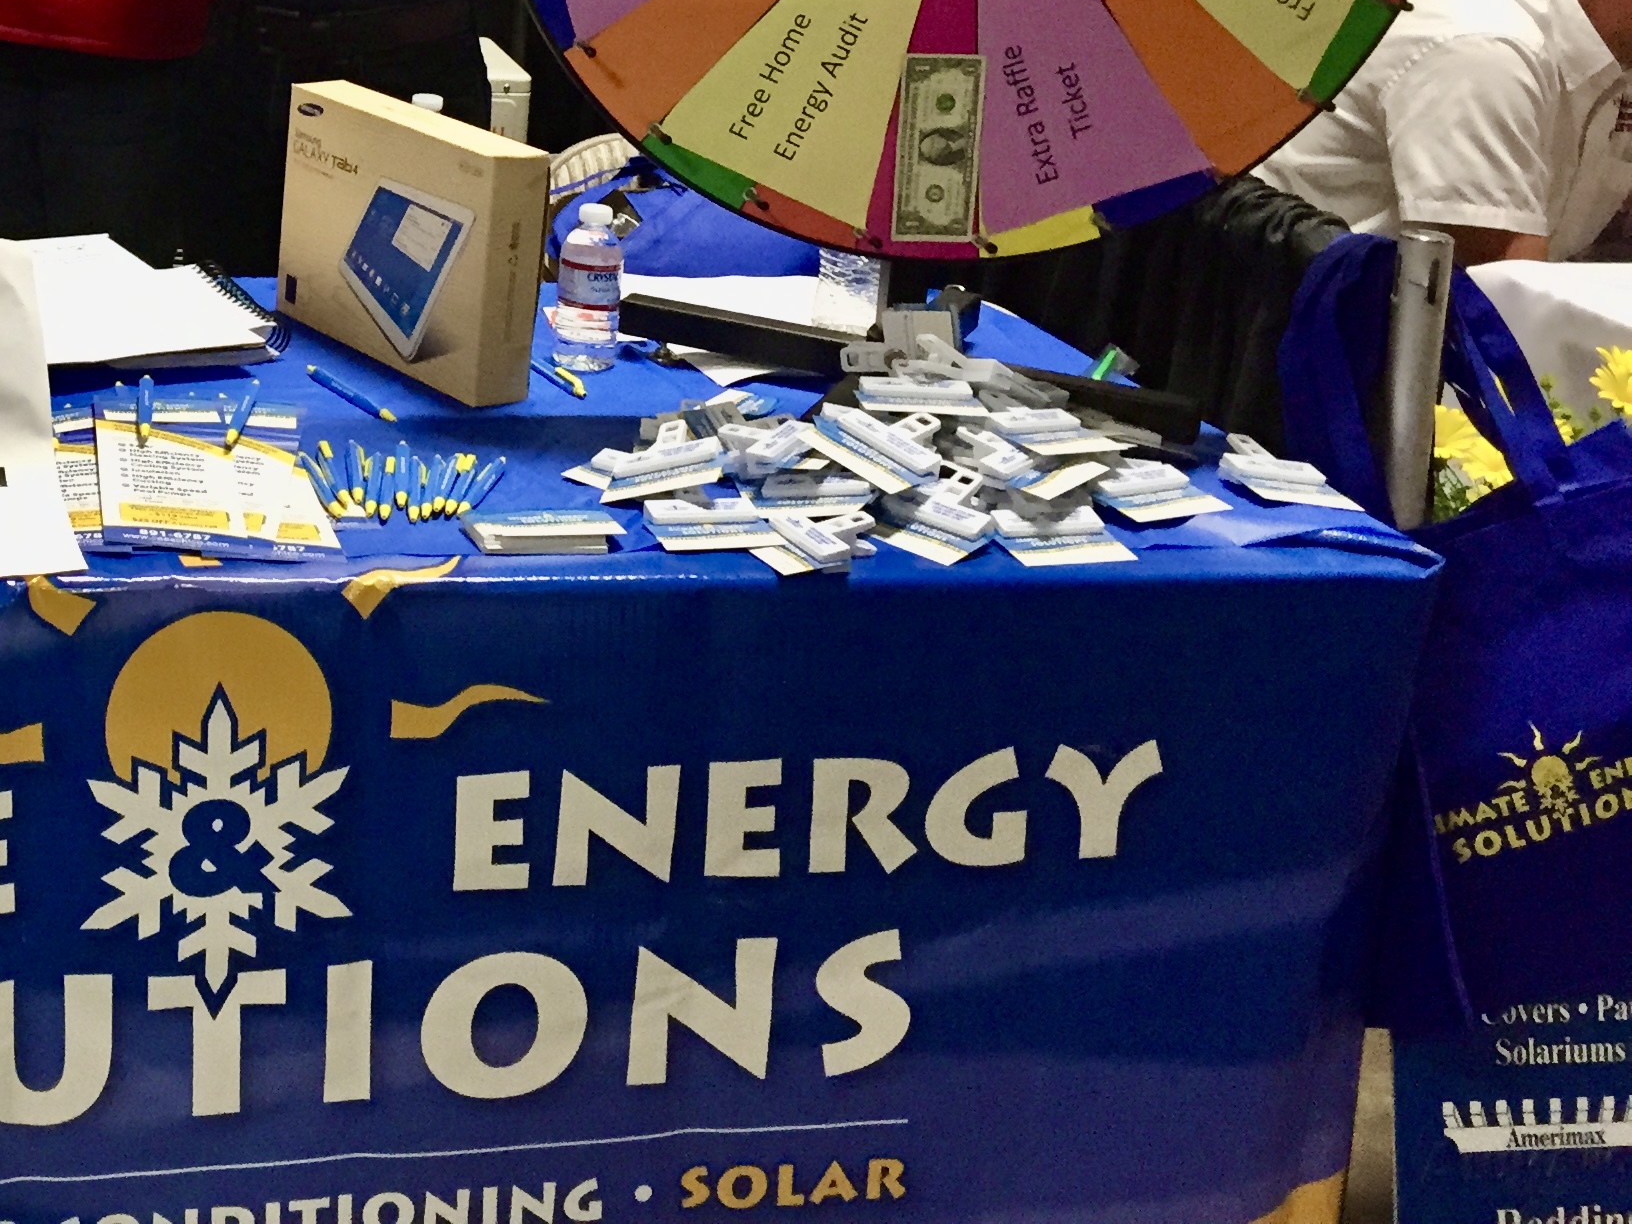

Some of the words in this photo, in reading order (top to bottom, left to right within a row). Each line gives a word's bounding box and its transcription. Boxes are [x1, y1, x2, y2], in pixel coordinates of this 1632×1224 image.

[729, 88, 771, 140] Free
[760, 13, 811, 84] Home
[773, 81, 834, 161] Energy
[821, 12, 868, 79] Audit
[1002, 44, 1039, 117] Raffle
[1056, 62, 1092, 139] Ticket
[1028, 122, 1059, 185] Extra
[451, 740, 1163, 893] ENERGY
[1495, 1037, 1627, 1067] Solariums
[1506, 1127, 1607, 1150] Amerimax
[680, 1158, 906, 1211] SOLAR
